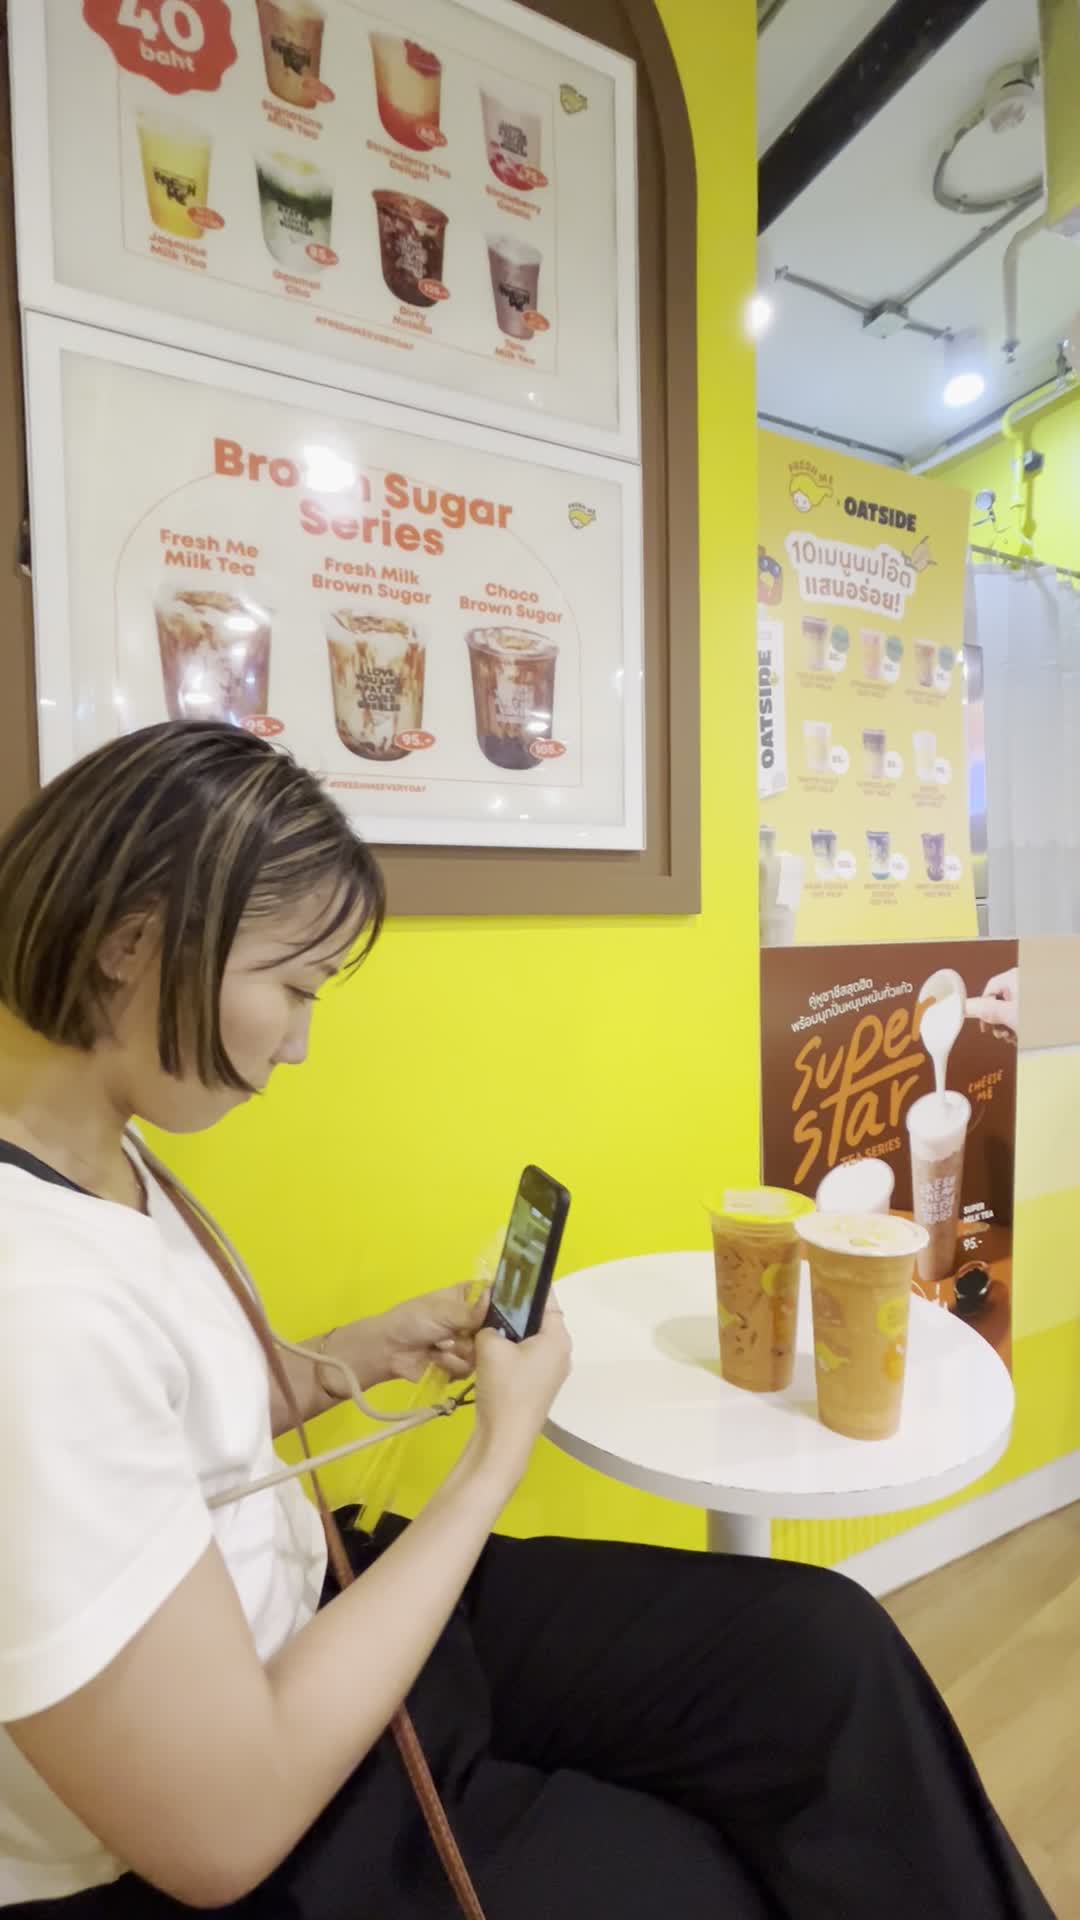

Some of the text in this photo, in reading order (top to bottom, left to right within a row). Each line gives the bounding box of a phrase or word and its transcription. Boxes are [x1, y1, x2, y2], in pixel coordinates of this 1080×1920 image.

[117, 0, 205, 52] 40
[139, 39, 195, 73] baht
[383, 472, 513, 528] Sugar
[843, 496, 918, 533] OATSIDE
[299, 498, 445, 556] Series
[159, 528, 259, 559] Fresh Me
[164, 549, 256, 577] Milk Tea
[324, 556, 420, 585] Fresh Milk
[311, 573, 432, 606] Brown Sugar
[485, 581, 540, 604] Choco
[805, 576, 901, 613] แสนอร่อย!
[459, 595, 563, 625] Brown Sugar
[758, 650, 775, 769] OATSIDE
[968, 1069, 1004, 1094] CHEESE
[977, 1085, 993, 1102] ME
[864, 1136, 902, 1158] SERIES
[981, 1209, 995, 1220] TEA
[963, 1236, 983, 1251] 95.-
